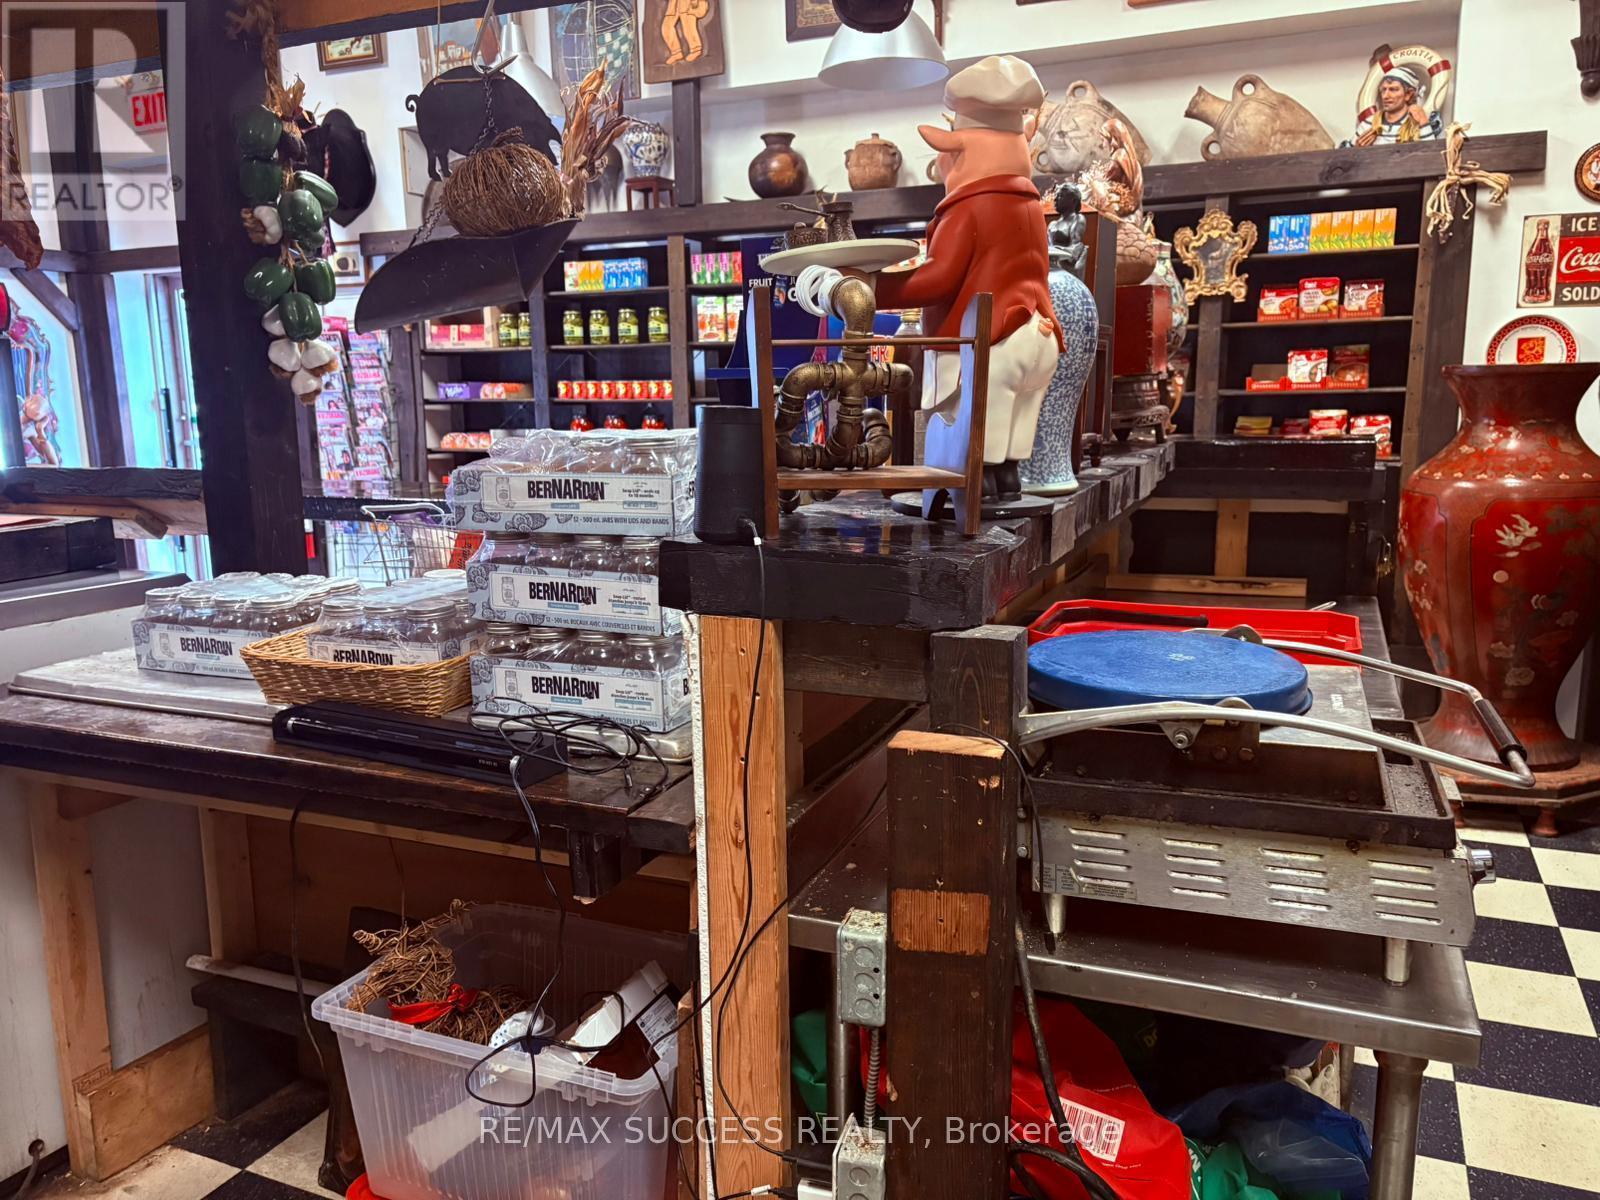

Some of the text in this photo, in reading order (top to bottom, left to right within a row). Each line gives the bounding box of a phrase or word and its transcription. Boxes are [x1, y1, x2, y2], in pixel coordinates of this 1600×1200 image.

[1393, 48, 1434, 63] CROATIA
[132, 92, 165, 127] EXIT
[1571, 216, 1598, 232] ICE
[748, 277, 773, 288] FRUIT
[1562, 286, 1600, 302] SOLD
[527, 478, 605, 501] BERNARDIN
[640, 517, 651, 525] AND
[529, 581, 597, 605] BERNARDIN
[180, 637, 233, 656] BERNARDIN
[531, 675, 600, 699] BERNARDIN
